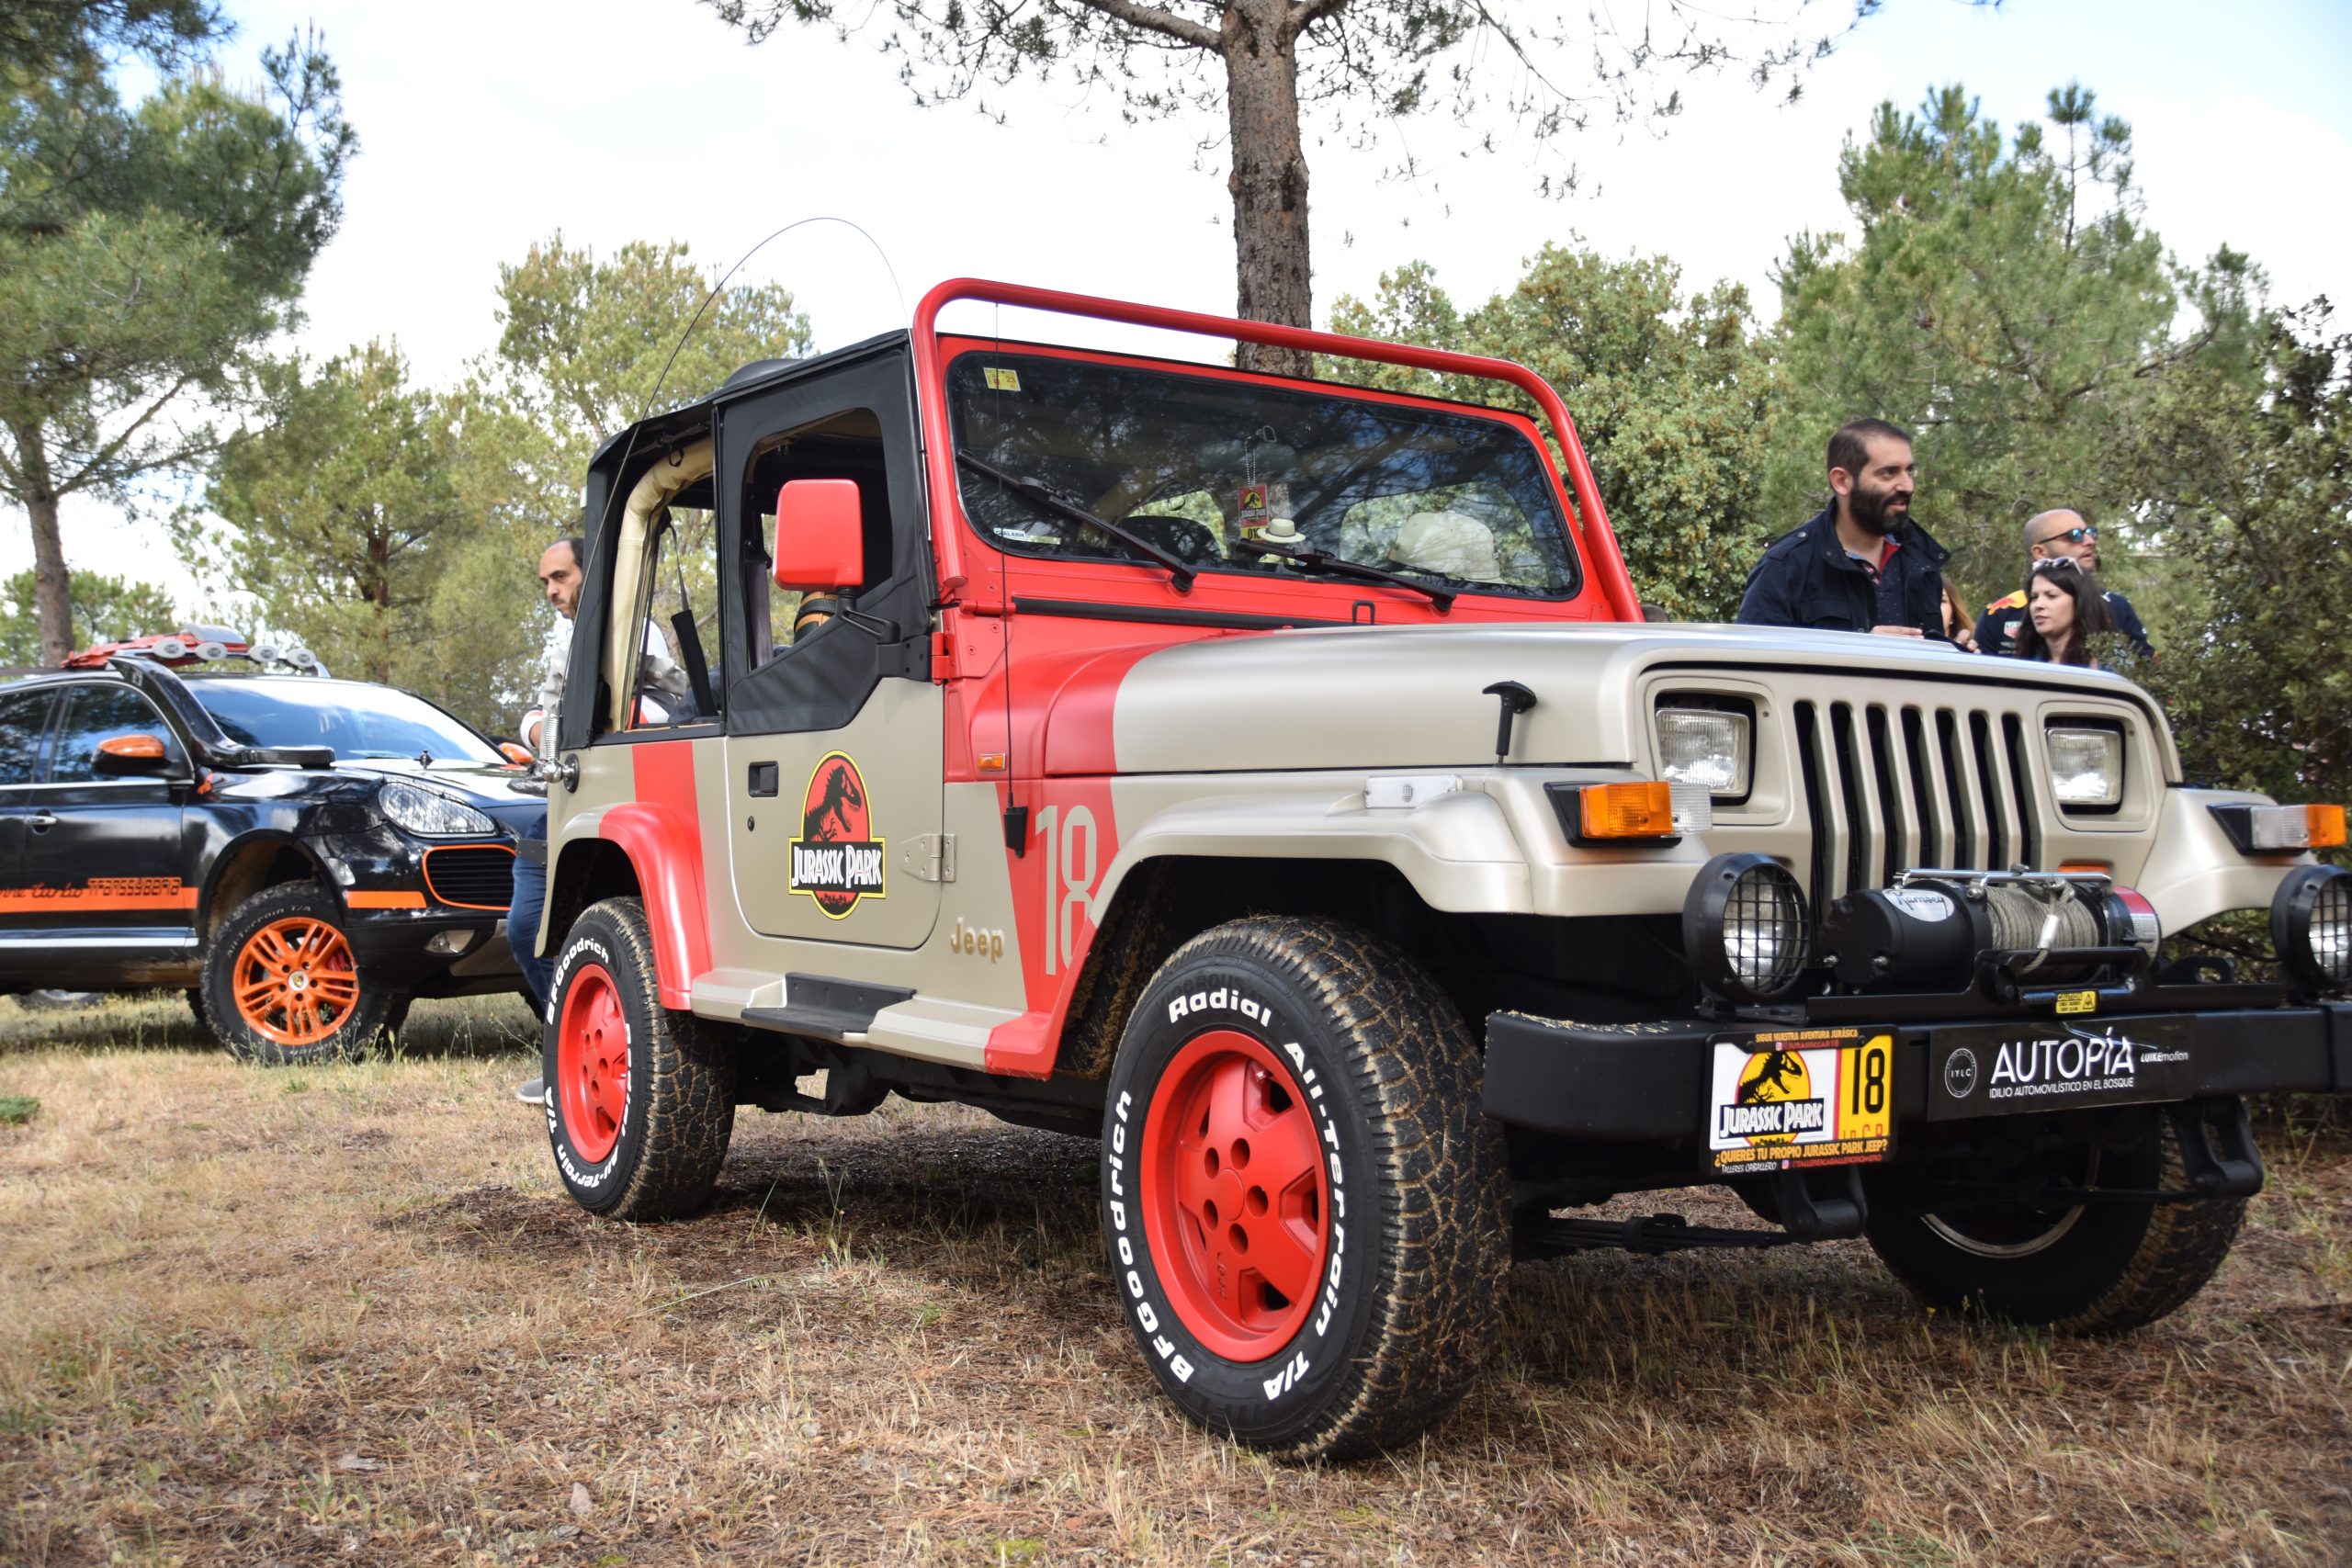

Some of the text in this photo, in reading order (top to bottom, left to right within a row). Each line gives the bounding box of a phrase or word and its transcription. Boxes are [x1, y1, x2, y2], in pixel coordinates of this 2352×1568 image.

[791, 844, 883, 889] JURASSIC PARK
[1035, 805, 1098, 976] 18
[1894, 889, 1949, 919] Ramsey
[950, 917, 1004, 964] Jeep
[546, 937, 610, 1026] BFGoodrich
[1168, 987, 1272, 1028] Radial
[1755, 1032, 1773, 1043] SIGUE
[1773, 1031, 1799, 1042] NUESTRA
[1800, 1030, 1830, 1040] AVENTURA
[1990, 1026, 2135, 1085] AUTOPÍA
[1851, 1048, 1885, 1115] 18
[1989, 1077, 2134, 1099] IDILIO AUTOMOVILÍSTICO EN EL BOSQUE
[546, 1086, 558, 1134] T/A
[1719, 1104, 1782, 1138] JURASSIC
[1783, 1101, 1824, 1133] PARK
[557, 1143, 619, 1189] All-Terrain
[1714, 1139, 1888, 1168] ¿QUIERES TU PROPIO JURASSIC PARK JEEP?
[1283, 1042, 1346, 1337] All-Terrain
[1109, 1090, 1194, 1383] BFGoodrich
[1262, 1350, 1310, 1401] T/A
